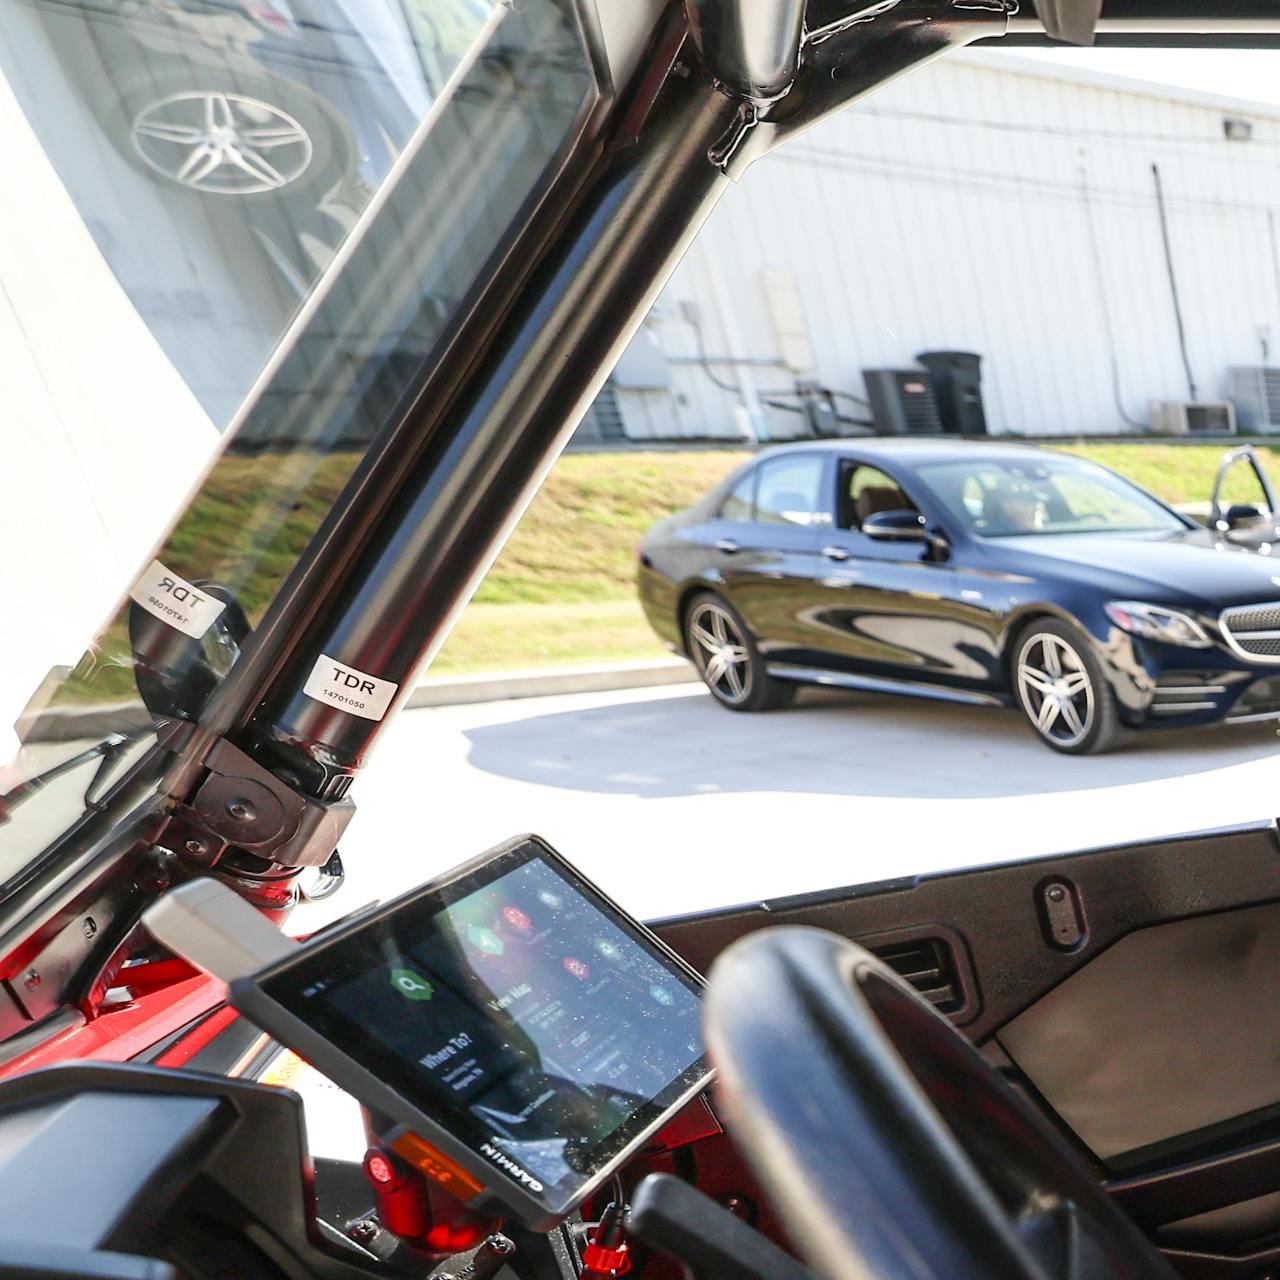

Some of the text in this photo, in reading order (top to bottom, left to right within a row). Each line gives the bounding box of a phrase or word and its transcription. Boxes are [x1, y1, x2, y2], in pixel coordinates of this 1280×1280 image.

[333, 667, 376, 695] TDR
[323, 689, 365, 709] 14701050
[419, 1045, 457, 1070] Where
[449, 1032, 473, 1049] To?
[480, 1143, 544, 1192] GARMIN
